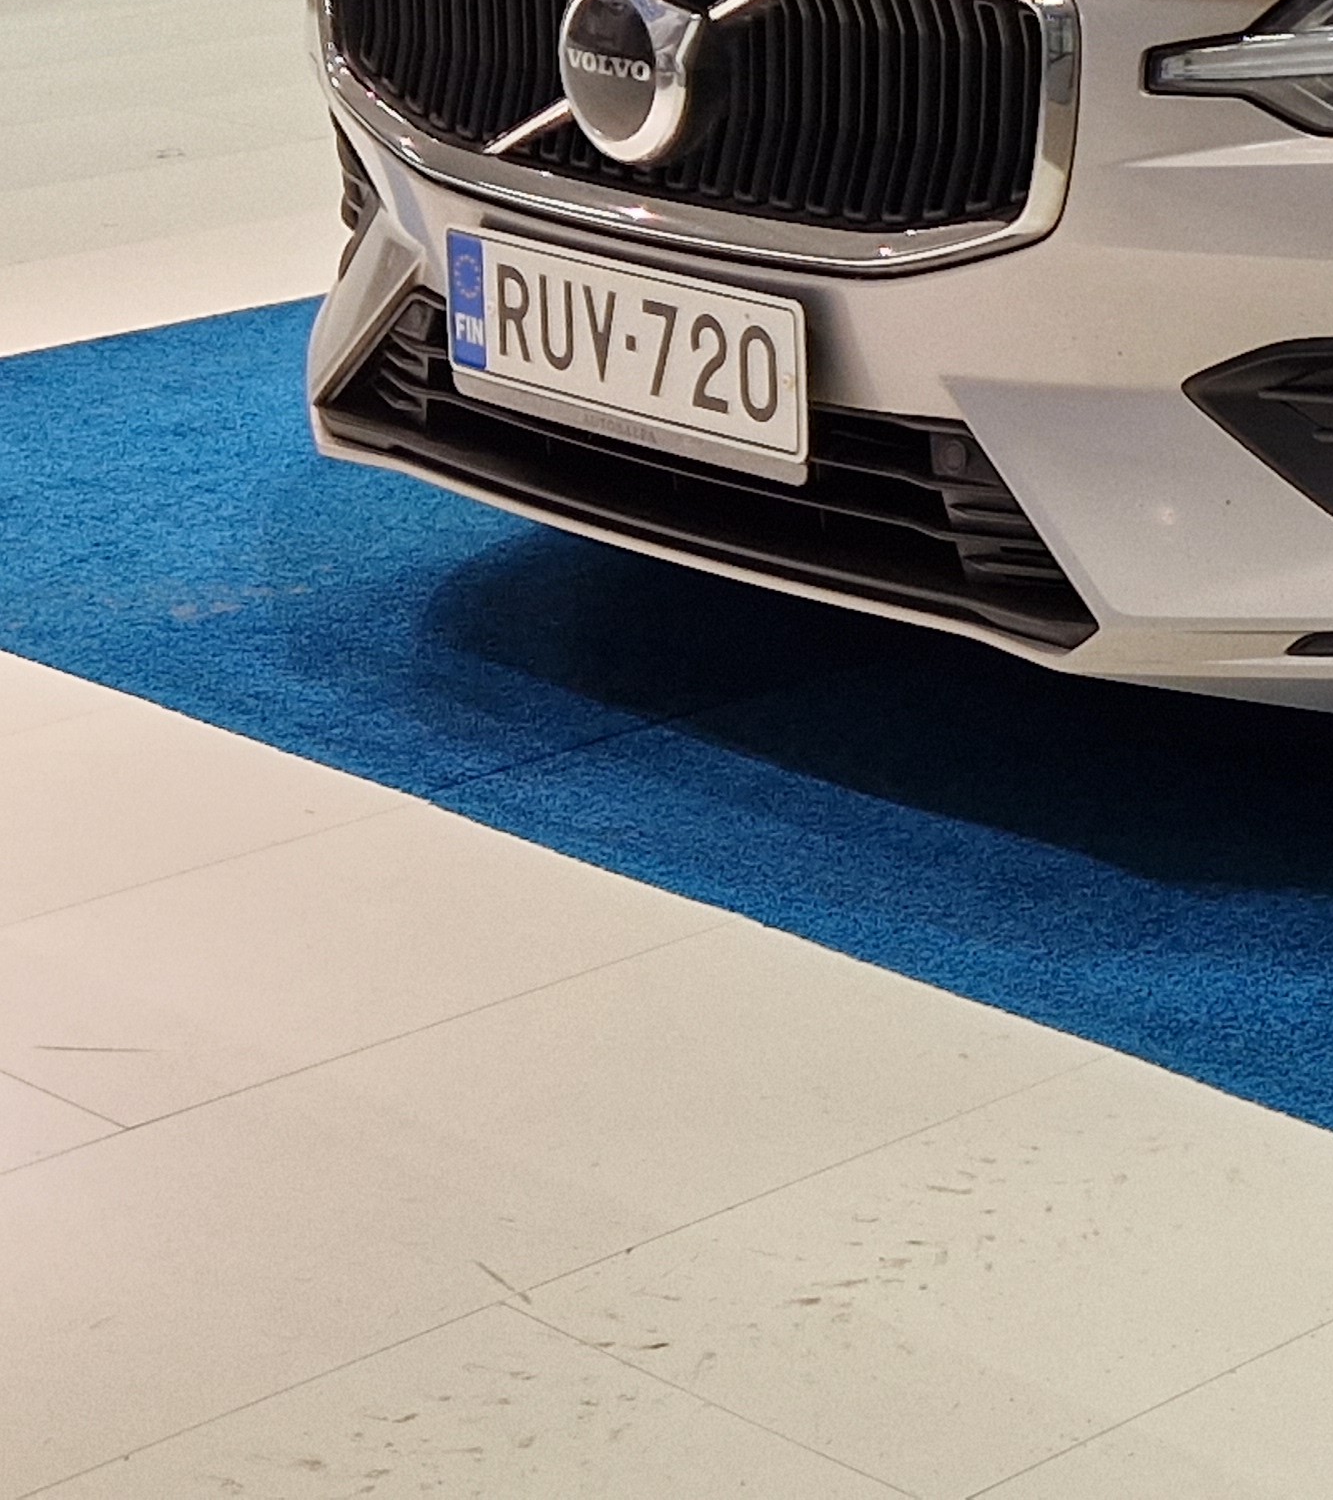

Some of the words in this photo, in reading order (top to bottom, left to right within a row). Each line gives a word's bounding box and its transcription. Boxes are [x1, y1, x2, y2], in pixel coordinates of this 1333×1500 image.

[566, 48, 651, 82] VOLVO
[454, 311, 485, 347] FIN
[497, 262, 778, 423] RUV-720
